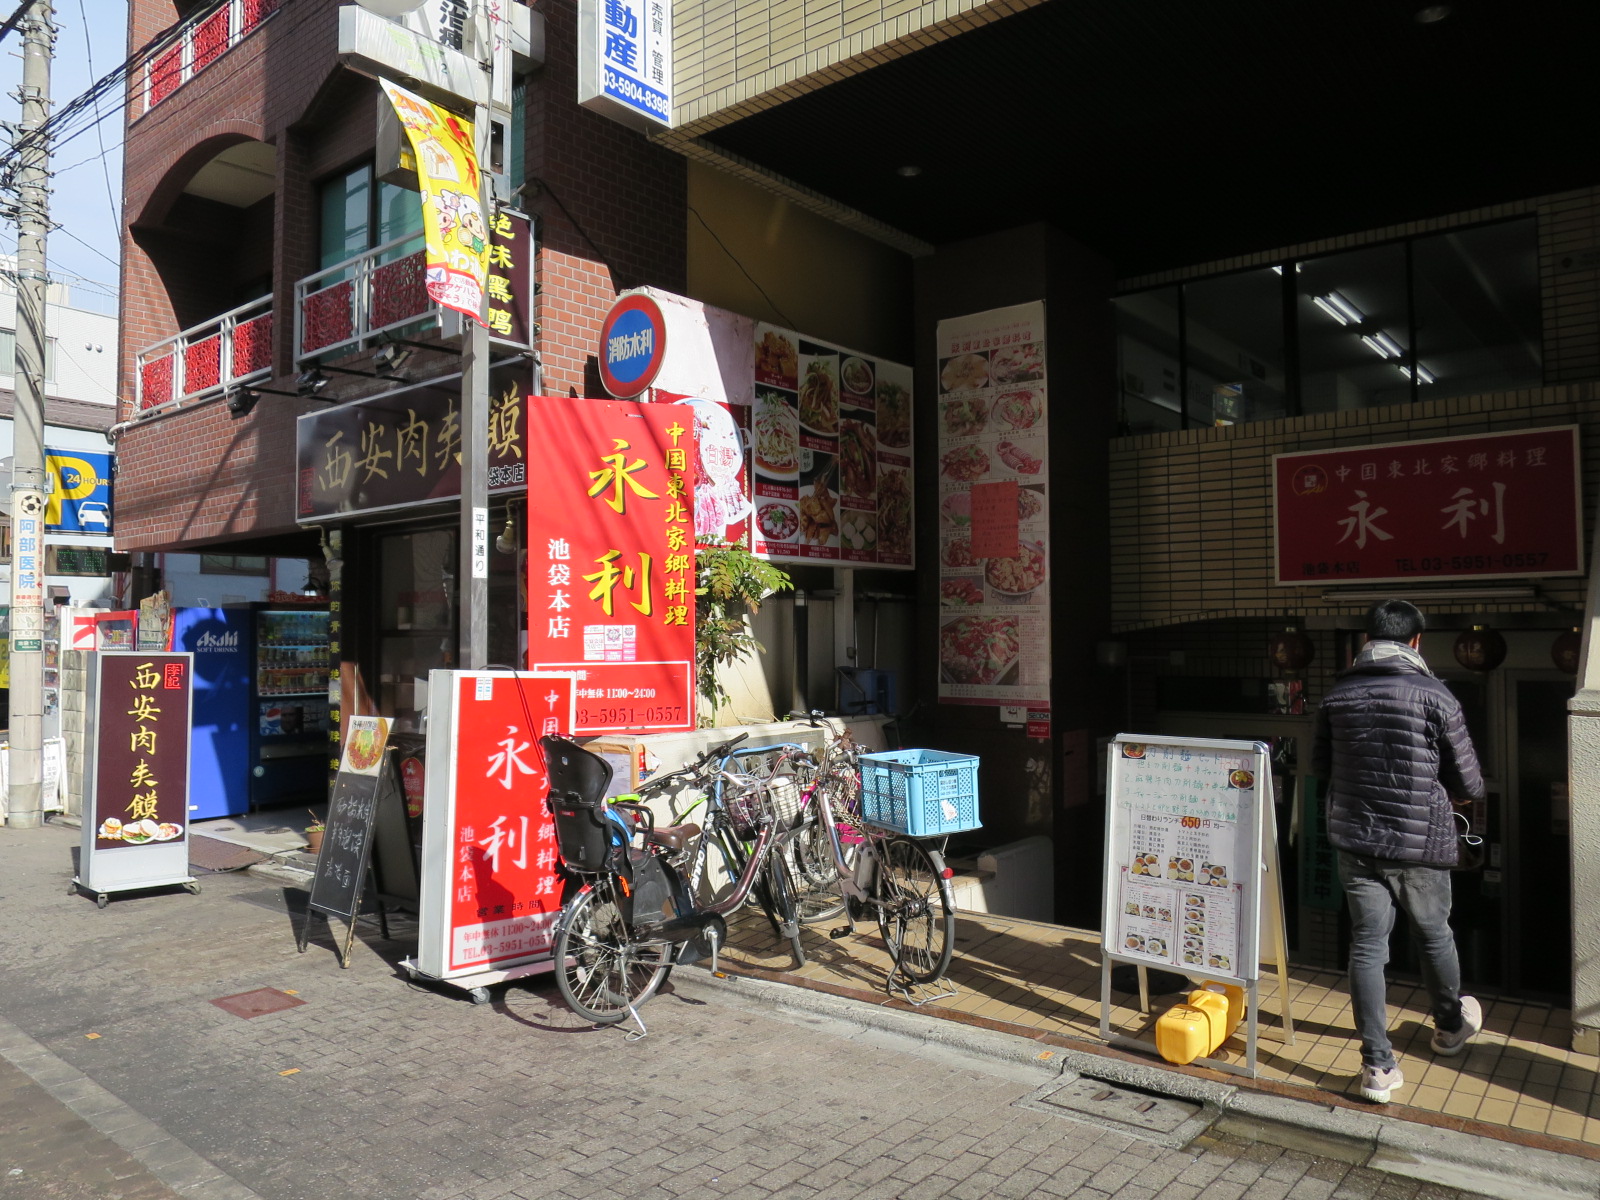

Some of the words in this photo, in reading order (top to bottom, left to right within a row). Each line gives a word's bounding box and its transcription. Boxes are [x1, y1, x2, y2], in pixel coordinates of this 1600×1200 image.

[604, 67, 668, 115] 03-5904-8398
[608, 328, 653, 364] 消防水利
[66, 473, 81, 484] 24
[487, 462, 524, 487] 袋本店
[1335, 447, 1547, 483] 中国東北家郷料理
[582, 438, 660, 617] 永利
[664, 421, 691, 626] 中国東北家郷料理
[1336, 481, 1506, 550] 永利
[19, 519, 35, 589] 阿部医院
[474, 513, 485, 572] 平和通り
[1302, 560, 1361, 576] 池袋本店
[1395, 558, 1416, 572] TEL
[1421, 552, 1550, 572] 03-5951-0557
[547, 538, 571, 638] 池袋本店
[196, 630, 239, 647] Asahi
[479, 726, 538, 873] 永利
[535, 689, 560, 896] 中国家郷料理
[1140, 813, 1179, 825] 日替わりランチ
[456, 826, 474, 902] 池袋本店
[477, 900, 541, 917] 営業時間
[463, 928, 499, 943] 年中無休
